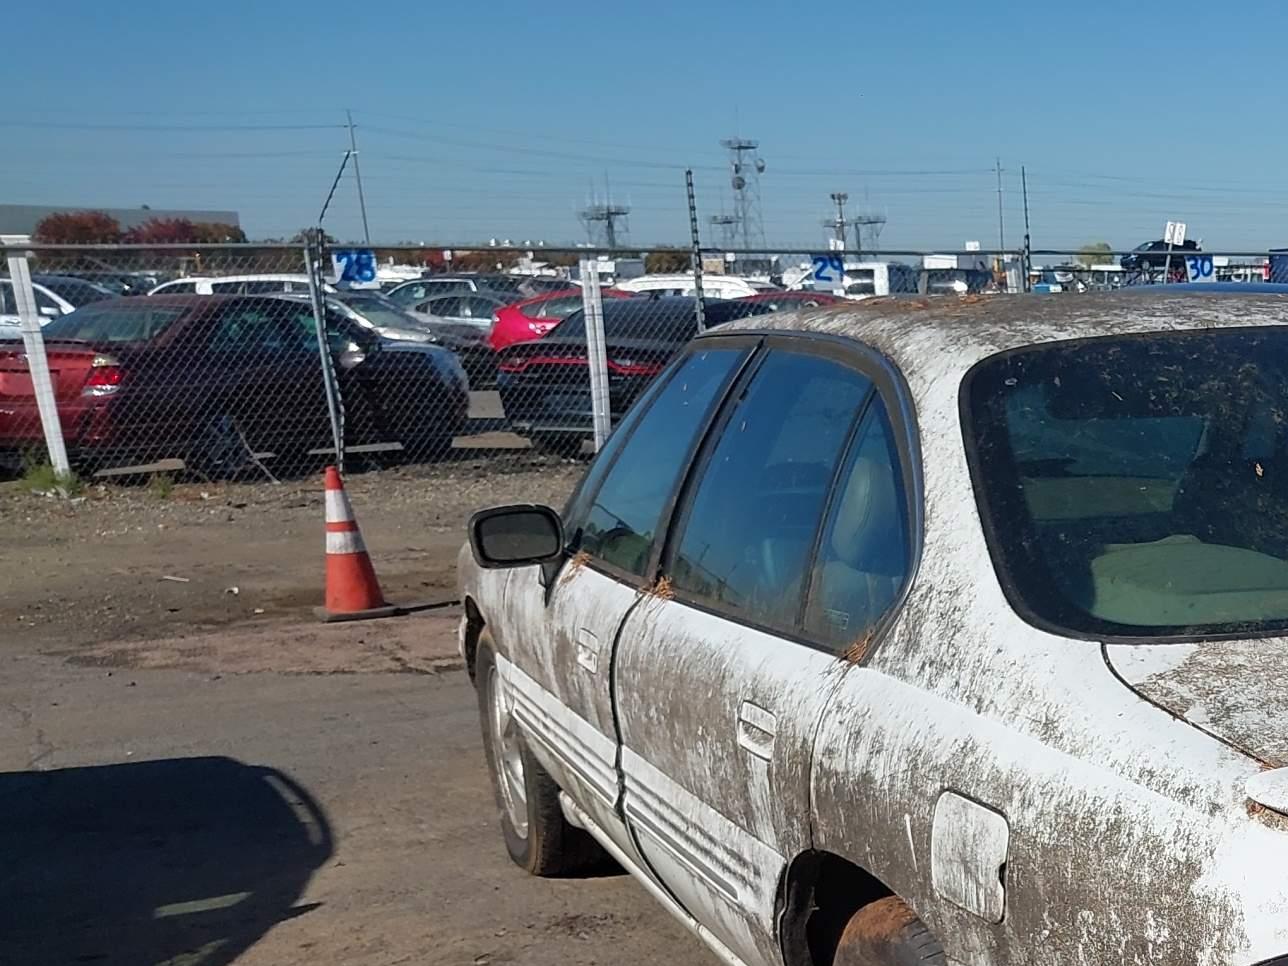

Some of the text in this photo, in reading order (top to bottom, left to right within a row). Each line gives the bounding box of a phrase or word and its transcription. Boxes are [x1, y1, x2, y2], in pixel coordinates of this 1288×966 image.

[336, 251, 376, 282] 28
[813, 255, 846, 282] 29
[1187, 256, 1213, 281] 30
